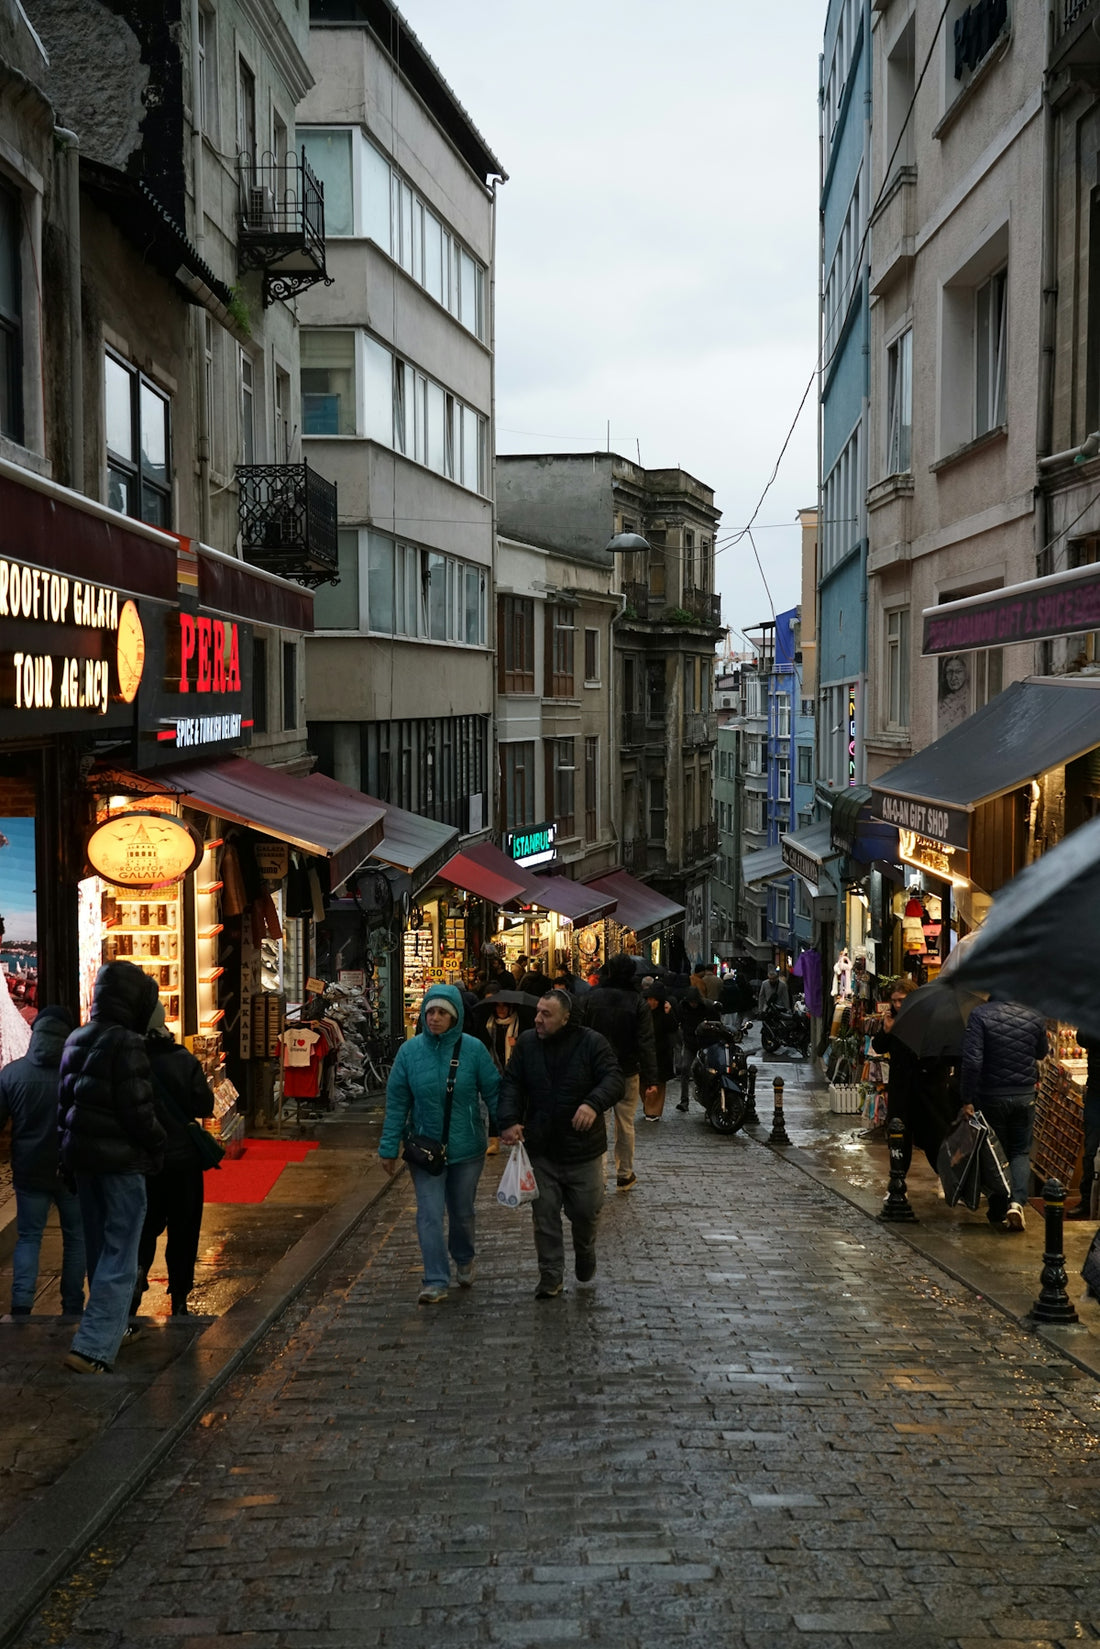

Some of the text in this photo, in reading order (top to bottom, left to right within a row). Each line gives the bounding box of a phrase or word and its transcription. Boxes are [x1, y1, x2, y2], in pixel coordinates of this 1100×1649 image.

[0, 559, 118, 631] ROOFTOP GALATA
[998, 602, 1023, 638] GIFT
[1036, 589, 1073, 631] SPICE
[179, 612, 242, 694] PERA
[14, 652, 53, 710] TOUR
[176, 714, 242, 748] SPICE & TURKISH DELIGHT
[909, 803, 927, 832] GIFT
[927, 808, 949, 839] SHOP
[118, 871, 166, 879] GALATA
[430, 969, 443, 977] 30
[445, 960, 457, 968] 50
